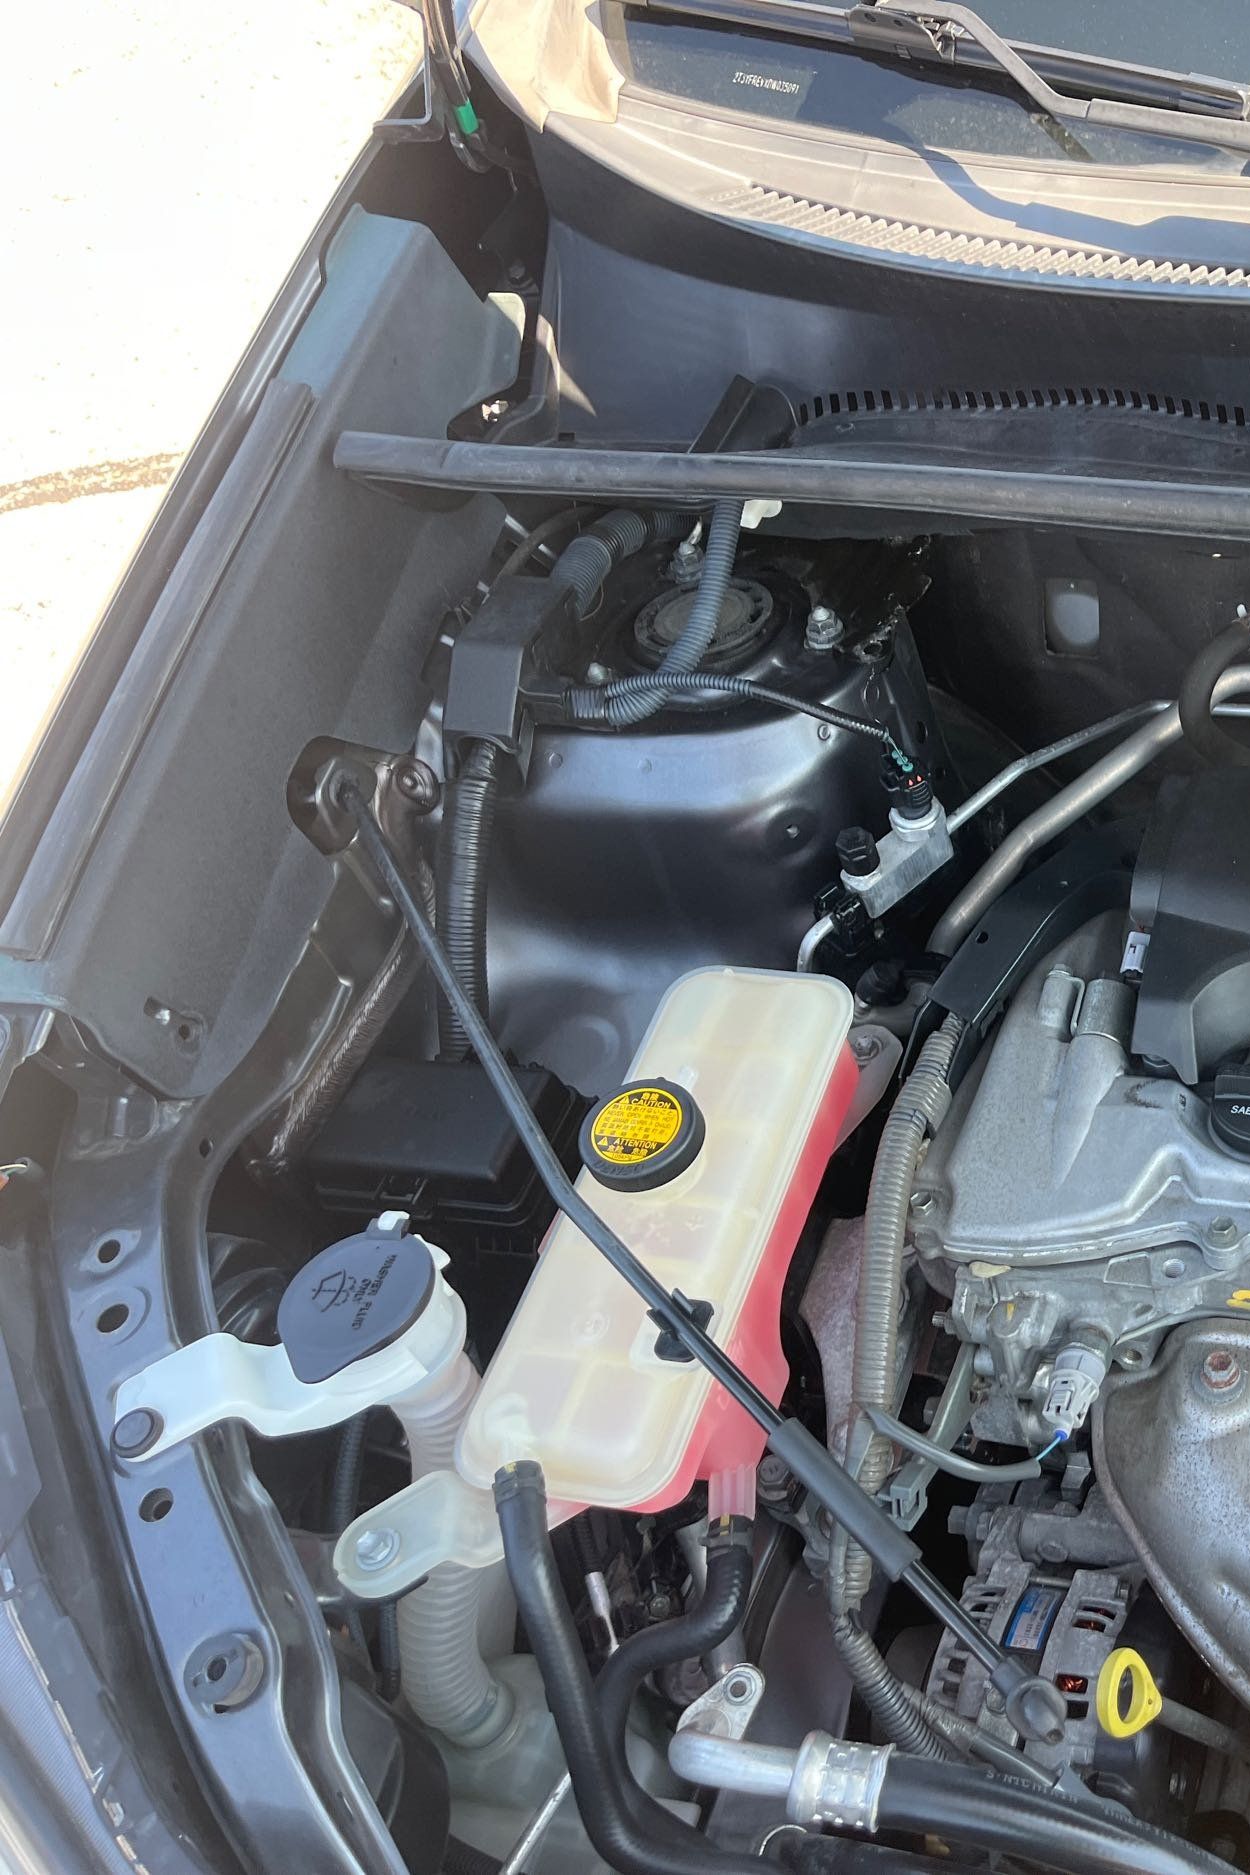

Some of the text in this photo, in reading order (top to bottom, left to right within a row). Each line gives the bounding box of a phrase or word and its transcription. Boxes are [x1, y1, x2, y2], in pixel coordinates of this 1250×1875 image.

[631, 1098, 672, 1109] CAUTION
[613, 1138, 658, 1150] ATTENTION
[351, 1254, 398, 1330] WASHER FLUID
[352, 1279, 371, 1301] ONLY
